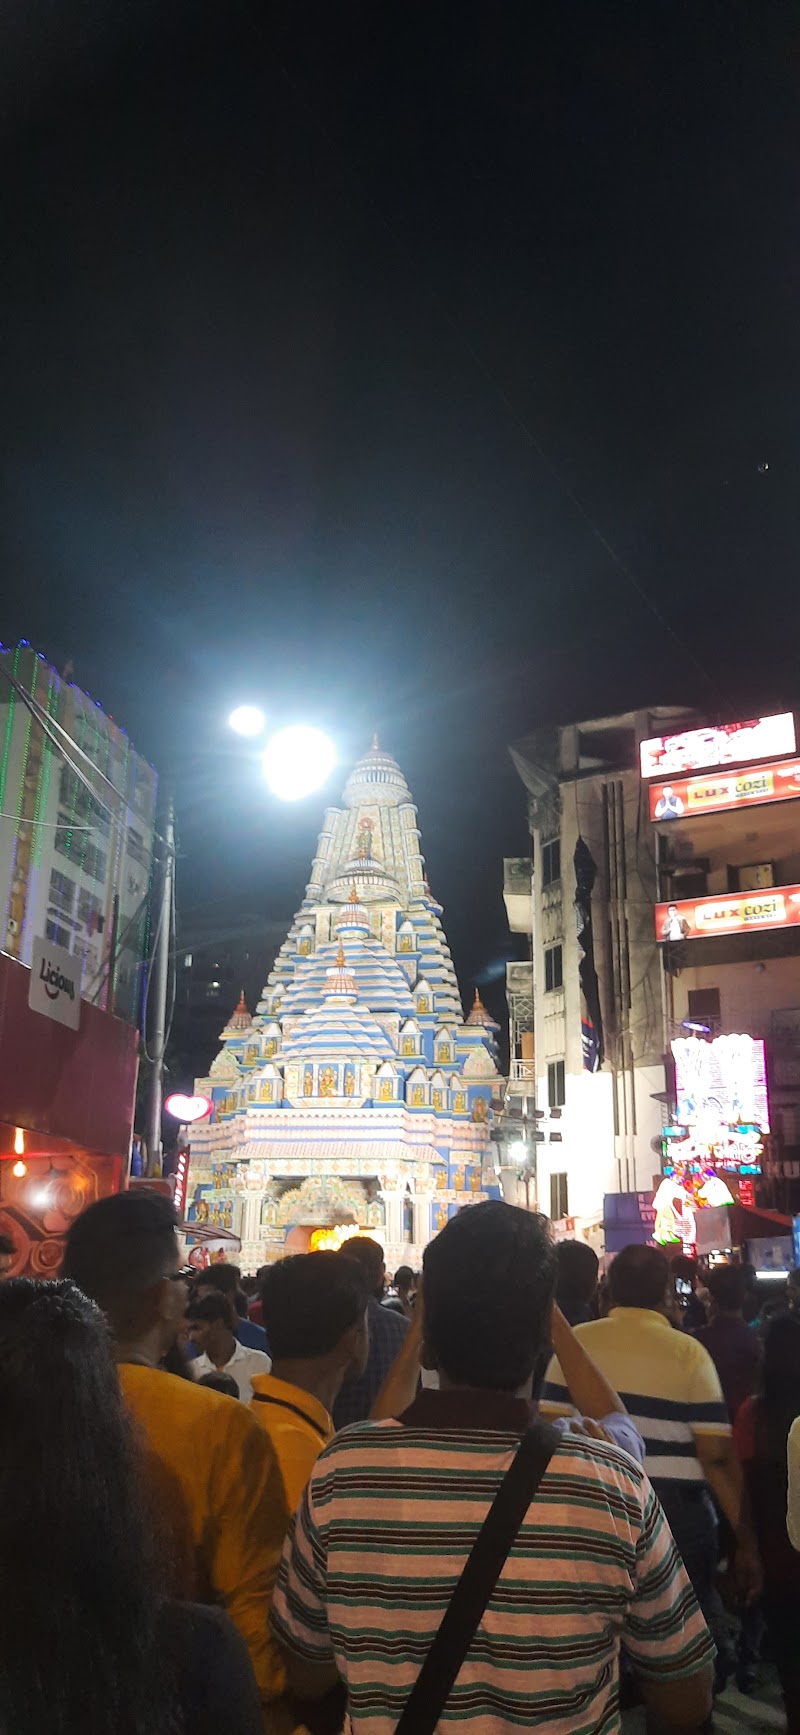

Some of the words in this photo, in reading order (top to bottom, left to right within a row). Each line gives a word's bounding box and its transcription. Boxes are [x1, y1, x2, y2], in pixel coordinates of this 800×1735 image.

[693, 786, 729, 799] LUX
[735, 776, 767, 793] cozi
[703, 908, 740, 920] LUX
[743, 899, 776, 916] cozi
[40, 958, 75, 1000] Licious
